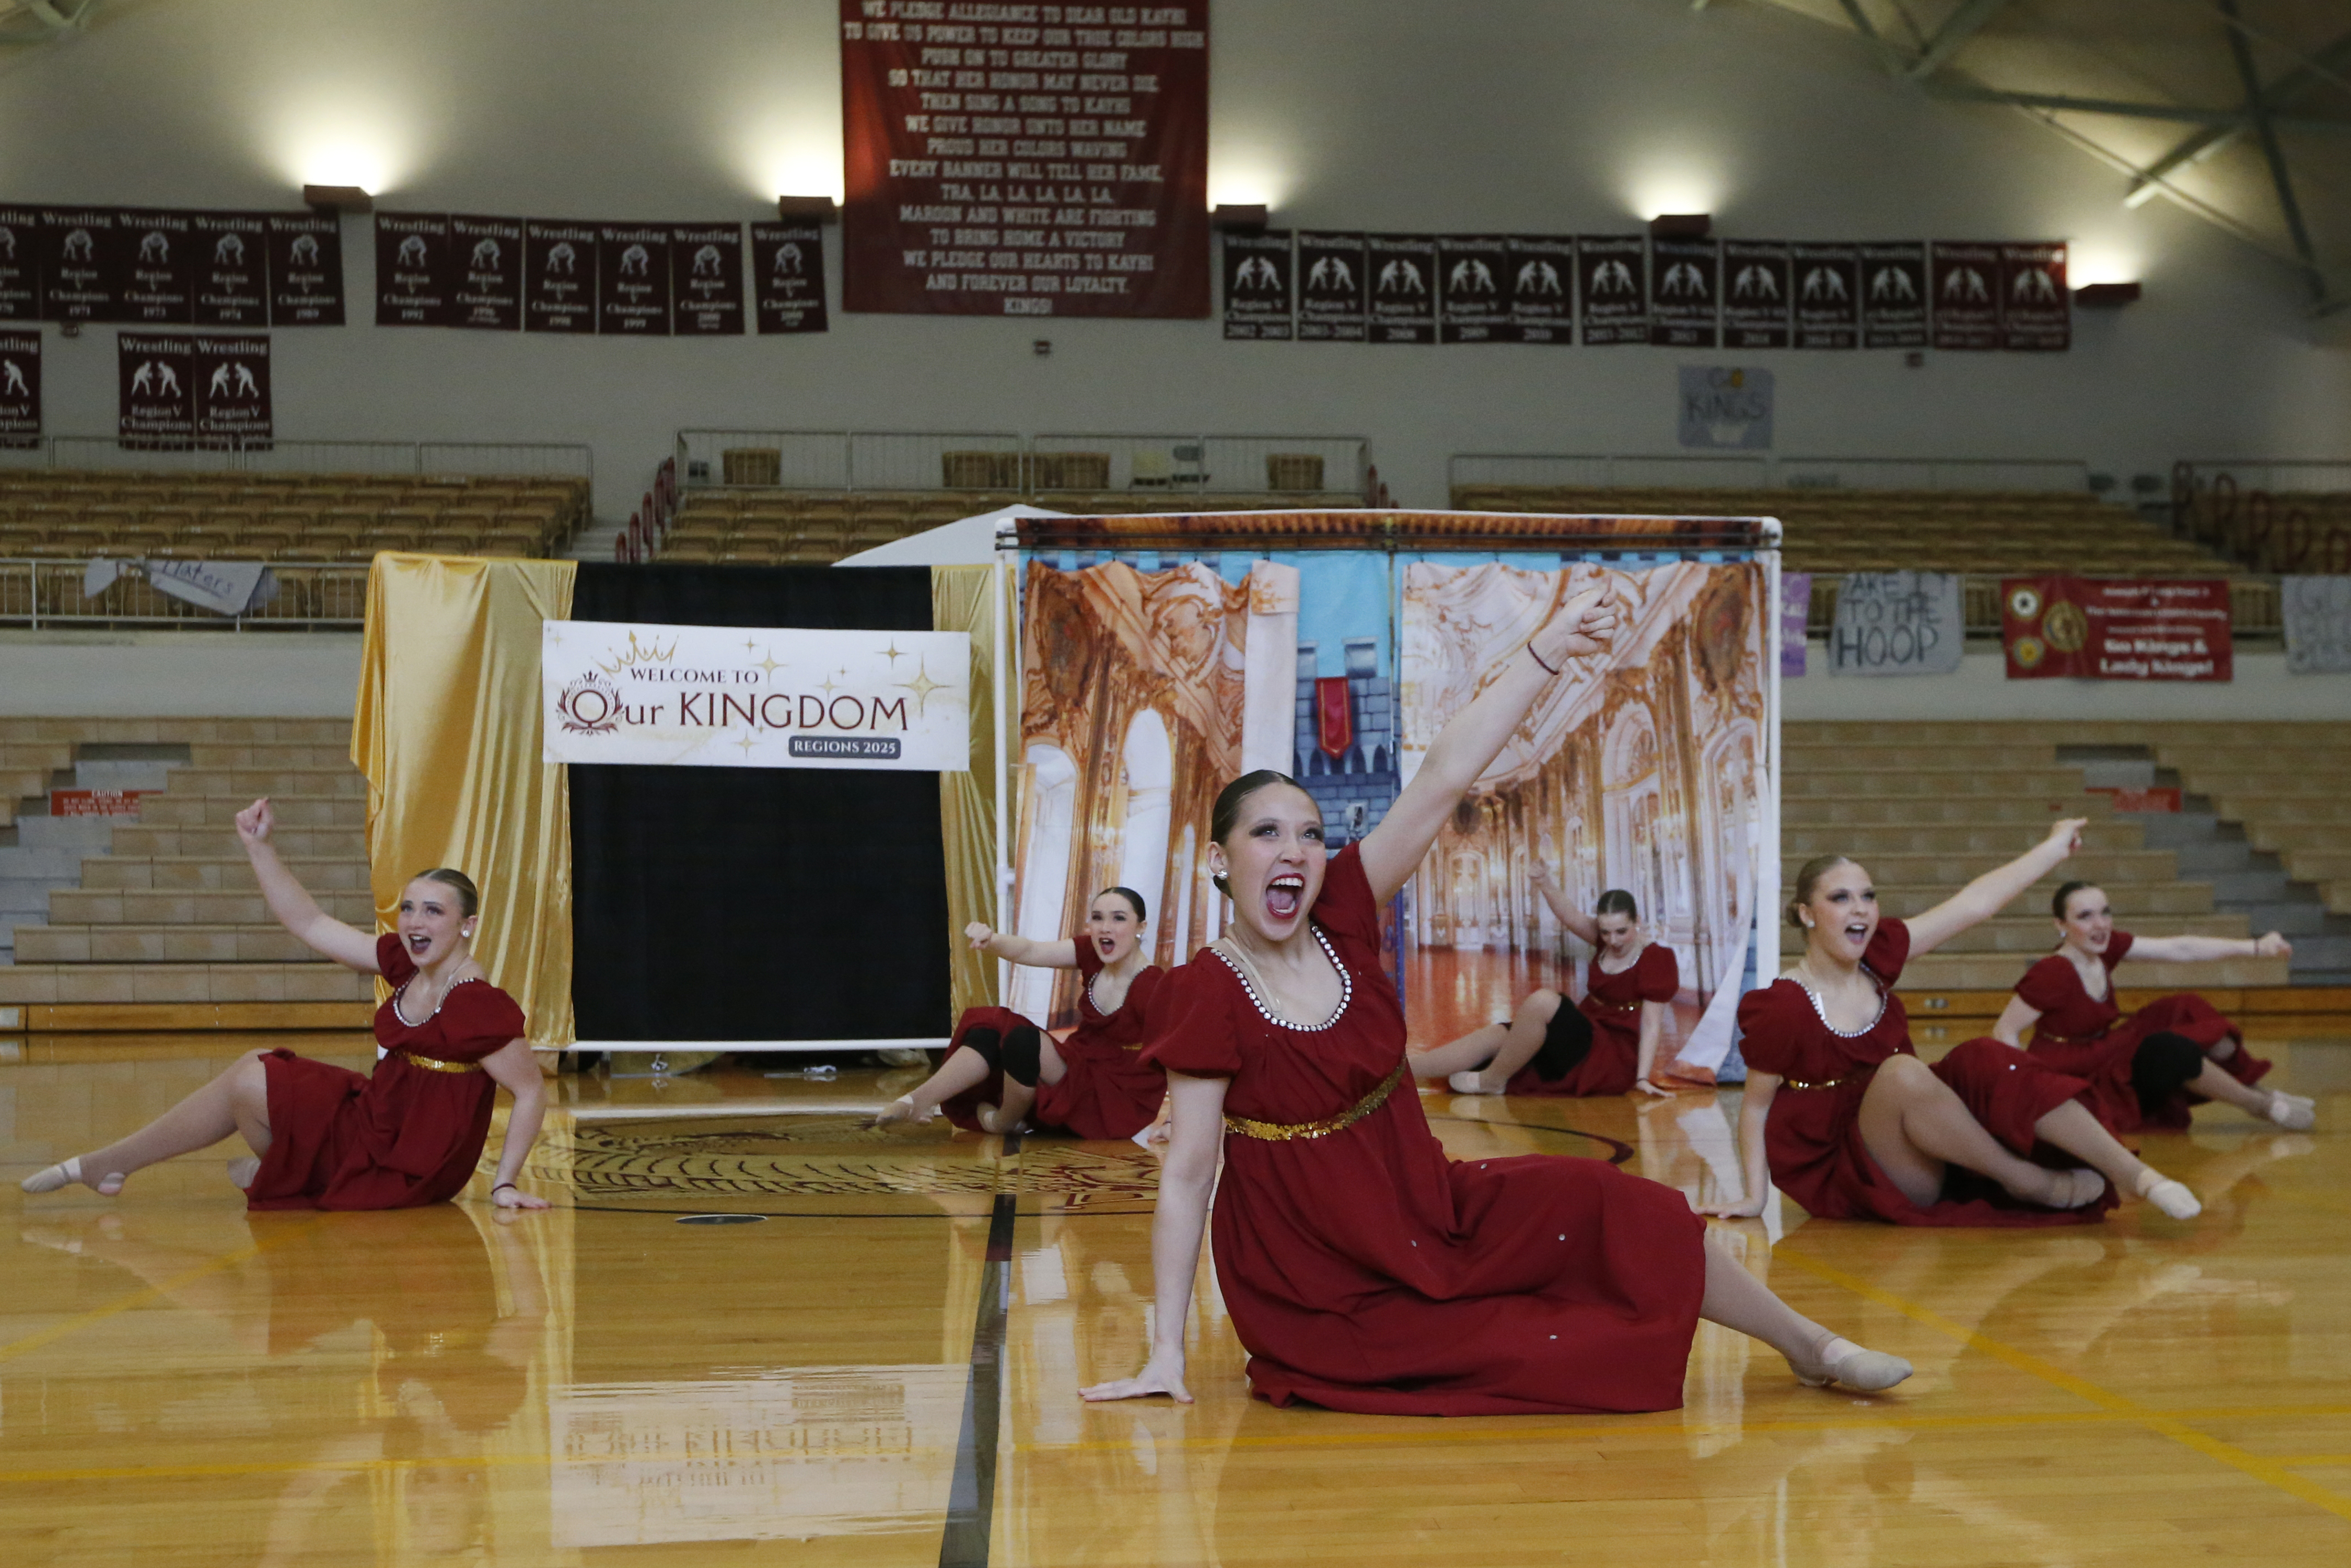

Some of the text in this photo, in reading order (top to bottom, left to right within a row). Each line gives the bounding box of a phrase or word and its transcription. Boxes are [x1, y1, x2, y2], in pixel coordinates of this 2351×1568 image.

[1002, 27, 1040, 46] KEEP
[1003, 95, 1015, 112] A
[905, 114, 929, 133] WE
[889, 158, 939, 177] EVERY
[1007, 162, 1043, 180] WILL
[1046, 162, 1084, 181] TELL
[900, 204, 962, 223] MAROON
[965, 206, 998, 224] AND
[1002, 207, 1051, 225] WHITE
[1054, 208, 1085, 225] ARE
[929, 228, 949, 245] TO
[1003, 230, 1045, 247] HOME
[1048, 230, 1061, 247] A
[902, 250, 927, 267] WE
[930, 250, 985, 268] PLEDGE
[1022, 252, 1080, 270] HEARTS
[1084, 253, 1103, 271] TO
[926, 273, 957, 291] AND
[961, 274, 1027, 292] FOREVER
[1031, 275, 1061, 292] OUR
[121, 338, 191, 354] Wrestling
[197, 339, 267, 355] Wrestling
[132, 404, 183, 418] Region V
[210, 404, 260, 419] Region V
[121, 415, 192, 432] Champions
[200, 417, 270, 433] Champions
[1841, 574, 1900, 599] AKE
[1843, 598, 1884, 624] TO
[1836, 625, 1939, 668] HOOP
[631, 668, 759, 684] WELCOME TO
[2099, 658, 2149, 677] Lady
[565, 685, 909, 731] Our KINGDOM
[794, 740, 896, 754] REGIONS 2025
